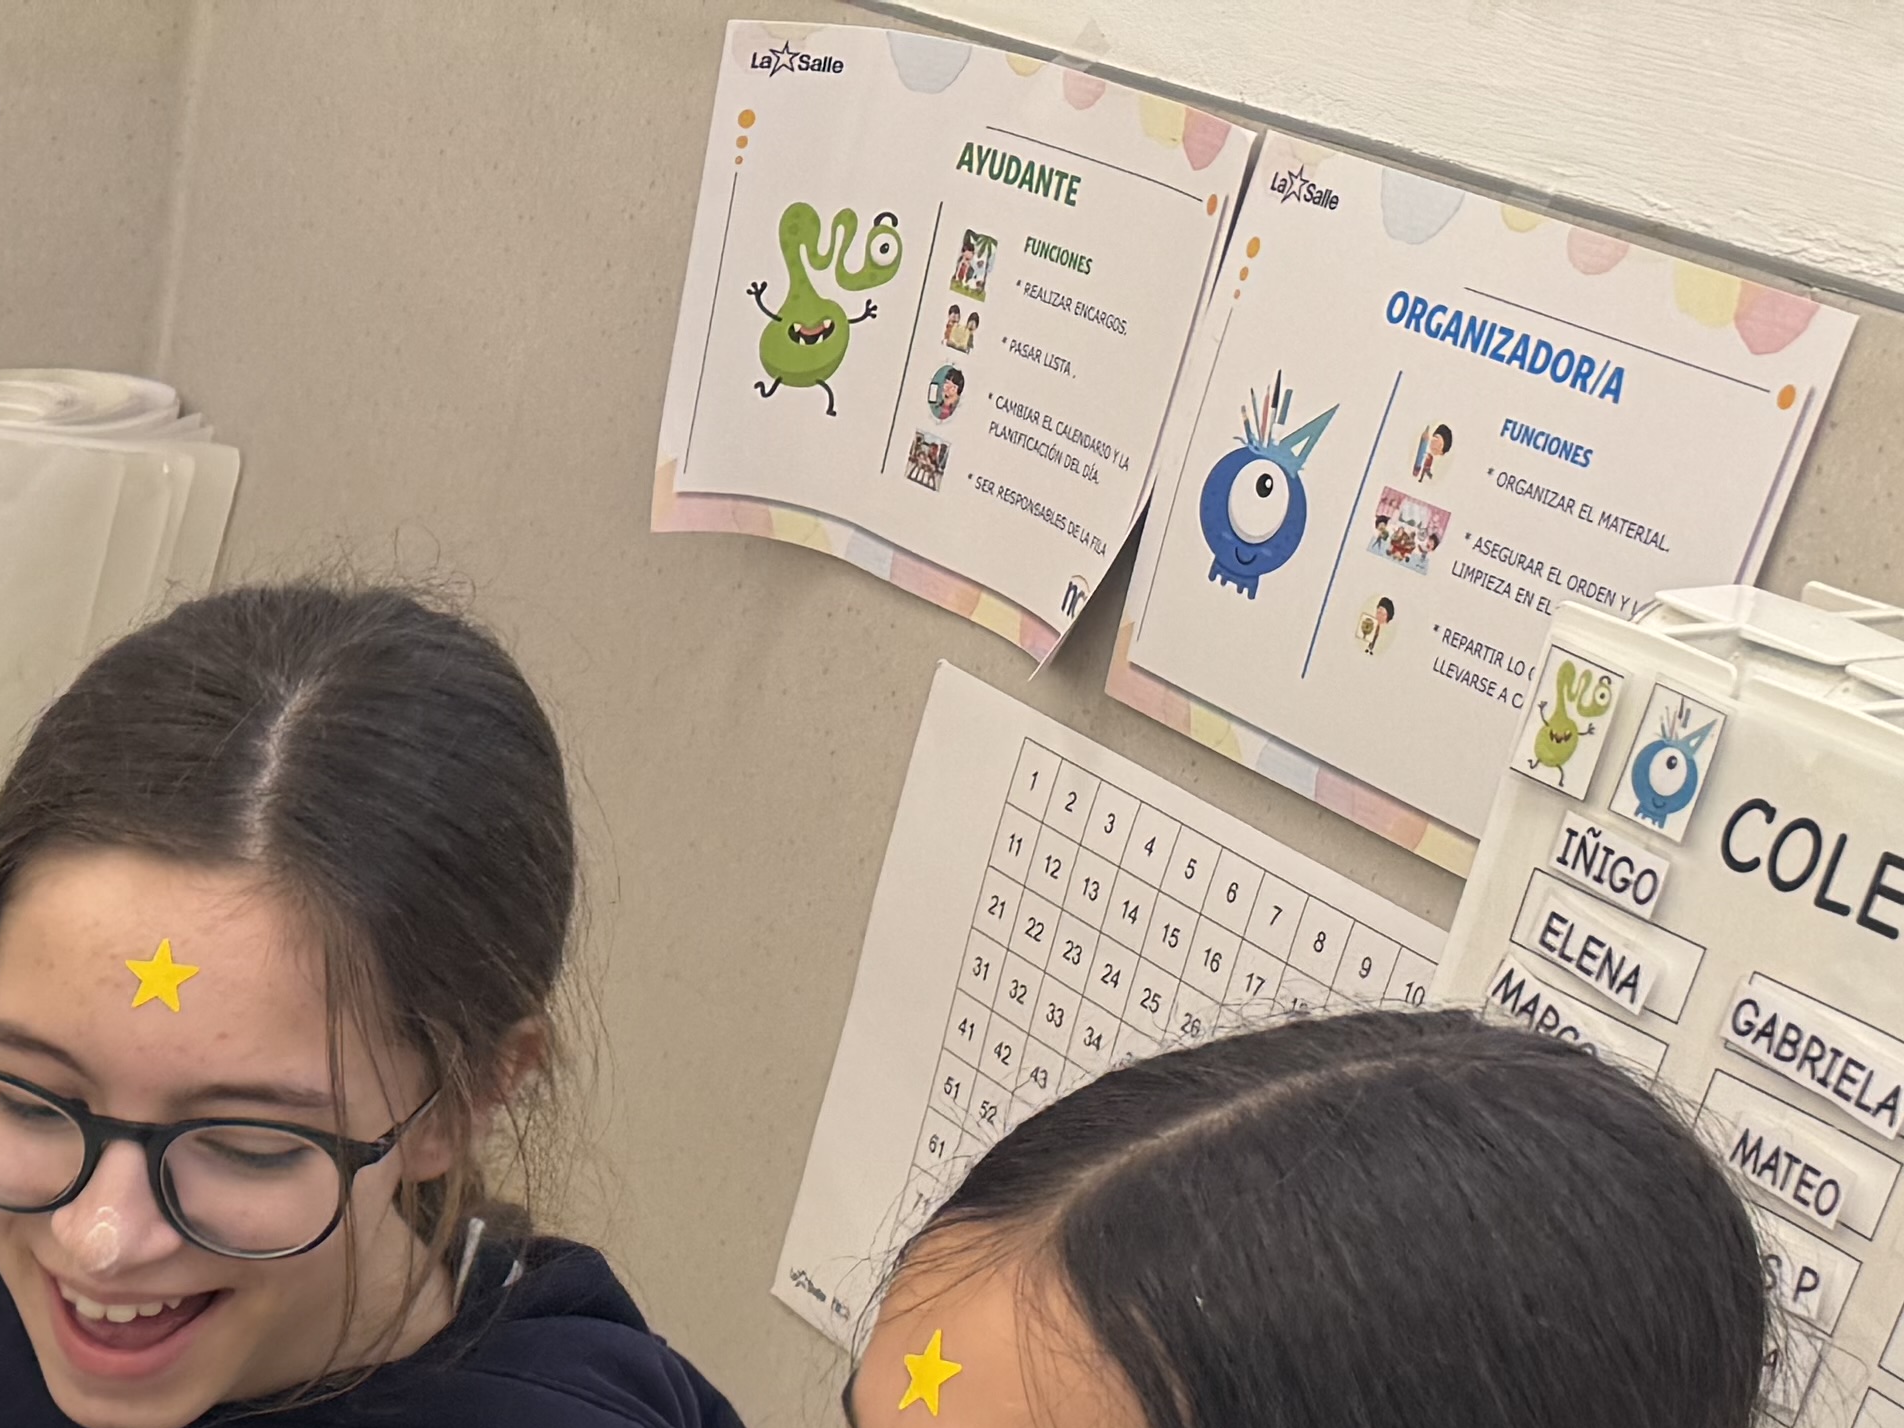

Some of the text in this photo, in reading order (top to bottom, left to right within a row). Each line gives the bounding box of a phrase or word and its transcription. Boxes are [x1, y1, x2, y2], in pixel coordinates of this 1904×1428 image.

[956, 142, 1081, 206] AYUDANTE
[1024, 236, 1093, 275] FUNCIONES
[1023, 282, 1127, 336] REALIZAR ENCARGOS.
[1009, 339, 1043, 364] PASAR
[1384, 289, 1626, 406] ORGANIZADOR/A
[988, 420, 1063, 465] PLANIFICACIÓN
[1063, 454, 1081, 475] DEL
[995, 395, 1130, 472] CAMBIAR EL CALENDARIO Y LA
[1499, 417, 1593, 468] FUNCIONES
[975, 476, 1107, 557] SER RESPONSABLES DE LA FILA
[1496, 472, 1670, 553] ORGANIZAR EL MATERIAL.
[1451, 560, 1553, 616] LIMPIEZA EN EL
[1472, 536, 1544, 579] ASEGURAR
[1547, 566, 1562, 586] EL
[1566, 574, 1617, 606] ORDEN
[1619, 594, 1630, 612] Y
[1432, 655, 1497, 697] LLEVARSE
[1497, 687, 1511, 703] A
[1442, 628, 1505, 668] REPARTIR
[1507, 656, 1525, 676] LO
[1028, 770, 1426, 1009] 1 2 3 4 5 6 7 8 9 10
[1555, 826, 1660, 906] IÑIGO
[1721, 799, 1904, 940] COLE
[1007, 831, 1266, 998] 11 12 13 14 15 16 17
[986, 894, 1202, 1040] 21 22 23 24 25 26
[1538, 910, 1643, 1006] ELENA
[971, 956, 1103, 1053] 31 32 33 34
[957, 1016, 1048, 1090] 41 42 43
[1730, 998, 1900, 1141] GABRIELA
[943, 1075, 998, 1124] 51 52
[928, 1133, 946, 1160] 61
[1729, 1127, 1840, 1218] MATEO
[1792, 1265, 1820, 1302] P
